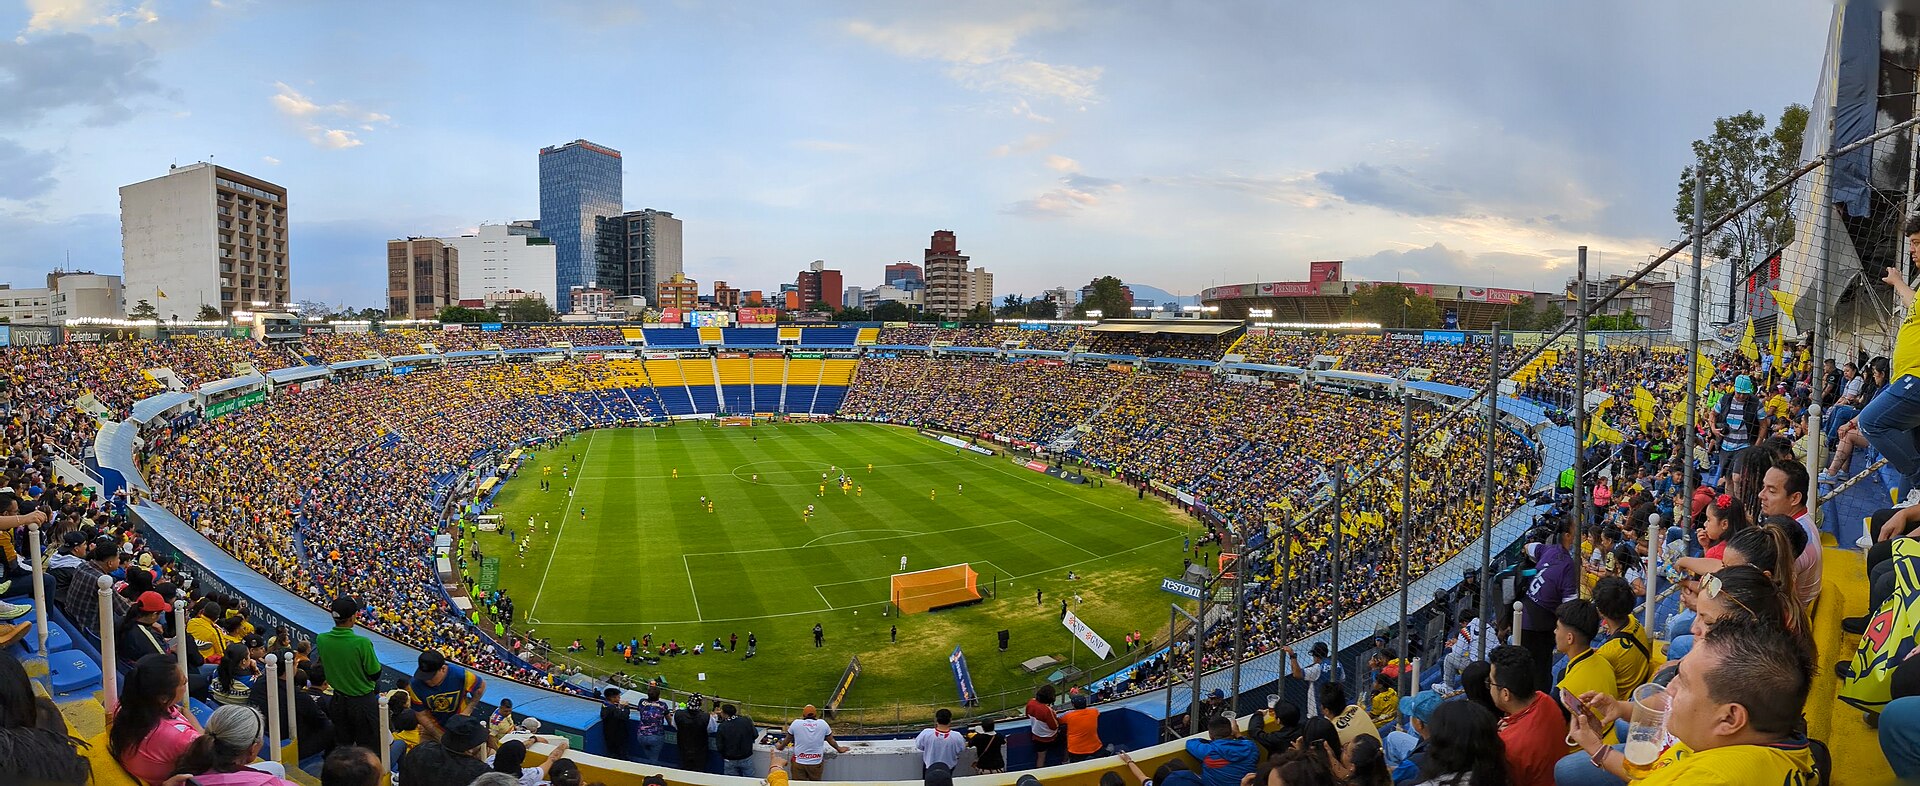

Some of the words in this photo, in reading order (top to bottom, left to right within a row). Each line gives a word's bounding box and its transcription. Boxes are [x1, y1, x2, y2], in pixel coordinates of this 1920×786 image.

[1274, 283, 1309, 294] PRESIDENTE
[71, 331, 101, 342] caliente.mx
[1274, 328, 1303, 337] caliente.mx
[1390, 331, 1424, 342] caliente.mx
[1320, 384, 1350, 396] caliente.mx
[1162, 577, 1201, 598] restoni
[197, 567, 228, 595] PROHIBIDO
[266, 613, 311, 642] OBETOS
[1091, 635, 1104, 650] GNP
